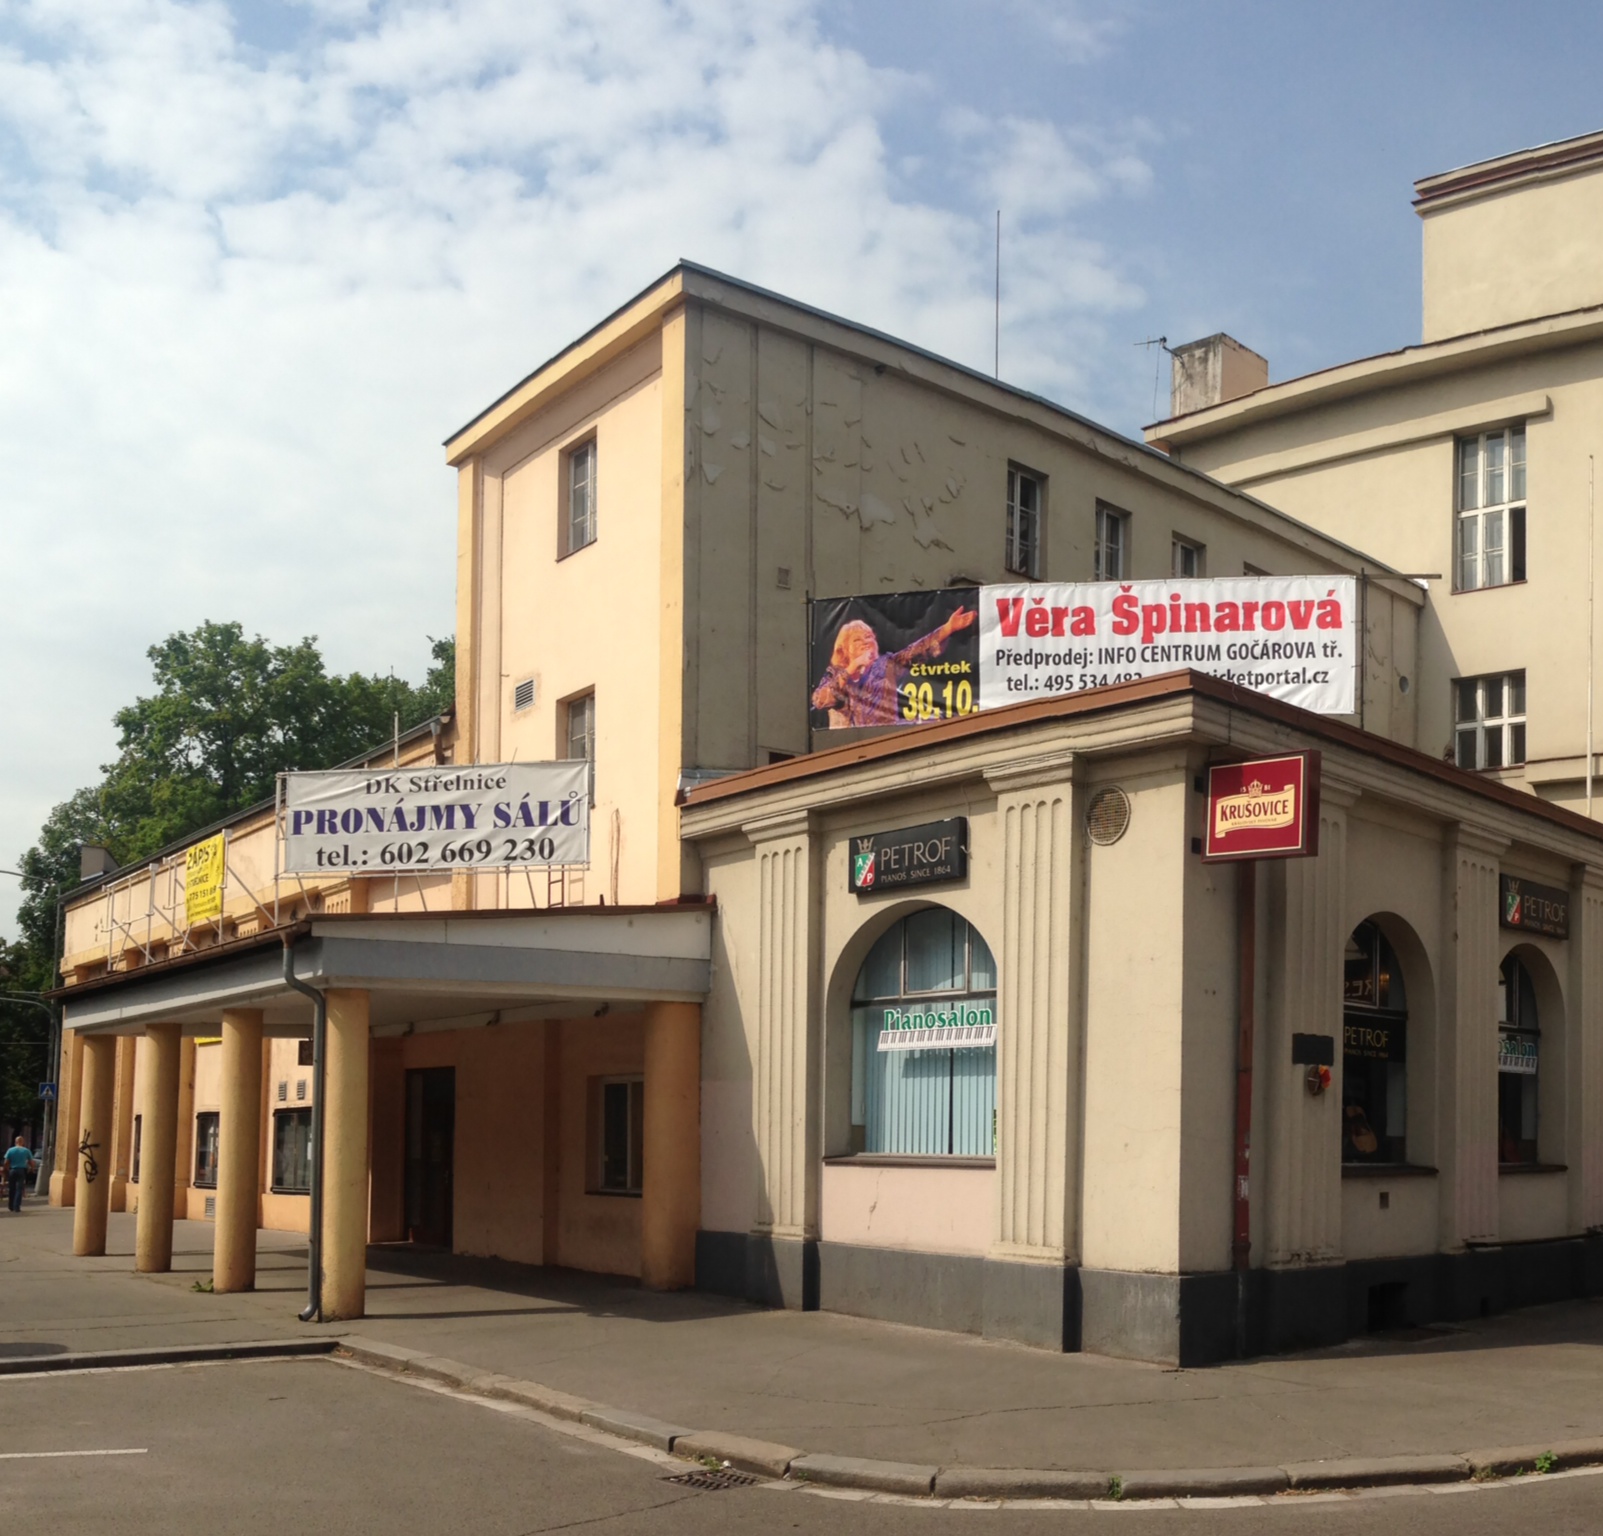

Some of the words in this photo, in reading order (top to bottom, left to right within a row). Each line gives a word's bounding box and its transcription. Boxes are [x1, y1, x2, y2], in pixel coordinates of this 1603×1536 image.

[996, 597, 1096, 638] Věra
[1111, 585, 1343, 644] Špinarová
[995, 648, 1094, 669] Předprodej:
[1098, 646, 1137, 665] INFO
[1140, 643, 1222, 663] CENTRUM
[1226, 639, 1317, 661] GOČÁROVA
[1322, 640, 1343, 658] tř.
[909, 660, 972, 677] čtvrtek
[1006, 674, 1040, 692] tel.:
[1043, 674, 1074, 691] 495
[1078, 673, 1109, 690] 534
[902, 679, 979, 721] 30.10.
[365, 778, 401, 795] DK
[408, 773, 507, 793] Střelnice
[290, 797, 484, 836] PRONÁJMY
[492, 790, 584, 831] SÁLŮ
[1220, 799, 1290, 822] KRUŠOVICE
[315, 844, 369, 868] tel.:
[379, 841, 430, 866] 602
[439, 838, 493, 864] 669
[502, 836, 555, 862] 230
[880, 837, 951, 870] PETROF
[880, 870, 908, 883] PIANOS
[910, 867, 930, 879] SINCE
[1523, 895, 1566, 923] PETROF
[883, 1004, 993, 1031] Pianosalon
[1344, 1026, 1389, 1048] PETROF
